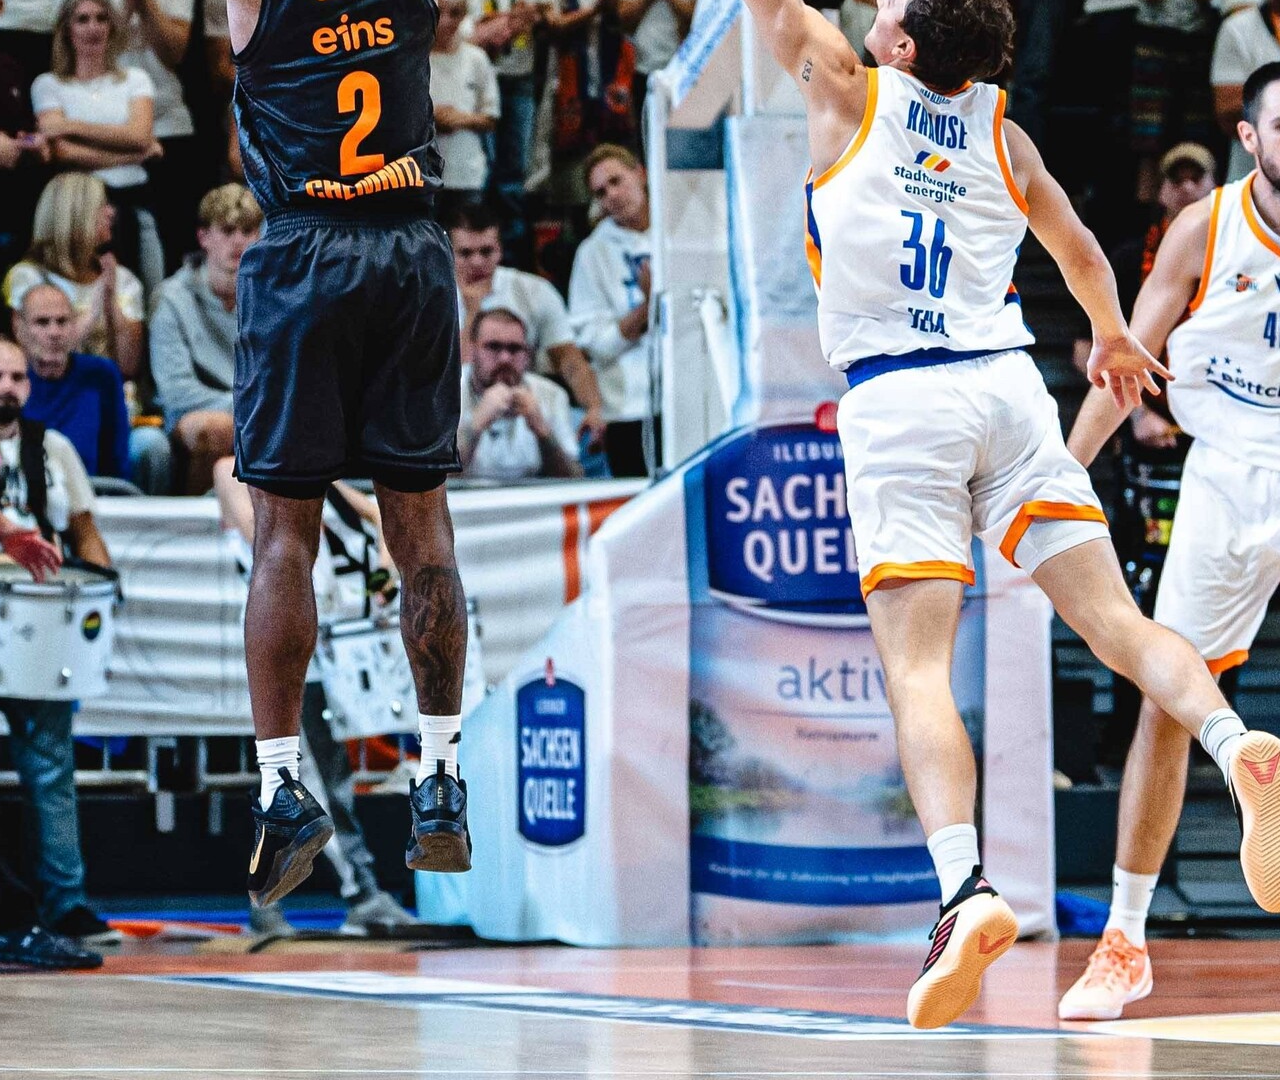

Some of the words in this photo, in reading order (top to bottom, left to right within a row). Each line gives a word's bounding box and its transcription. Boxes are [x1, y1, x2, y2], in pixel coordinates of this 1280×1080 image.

[312, 13, 395, 55] eins
[336, 70, 385, 177] 2
[894, 164, 967, 198] stadtwerke
[904, 182, 956, 204] energie
[900, 209, 953, 299] 36
[772, 441, 844, 463] ILEBU
[725, 472, 847, 523] SACH
[742, 527, 859, 583] QUEL
[521, 727, 581, 769] SACHSEN
[523, 777, 576, 826] QUELLE
